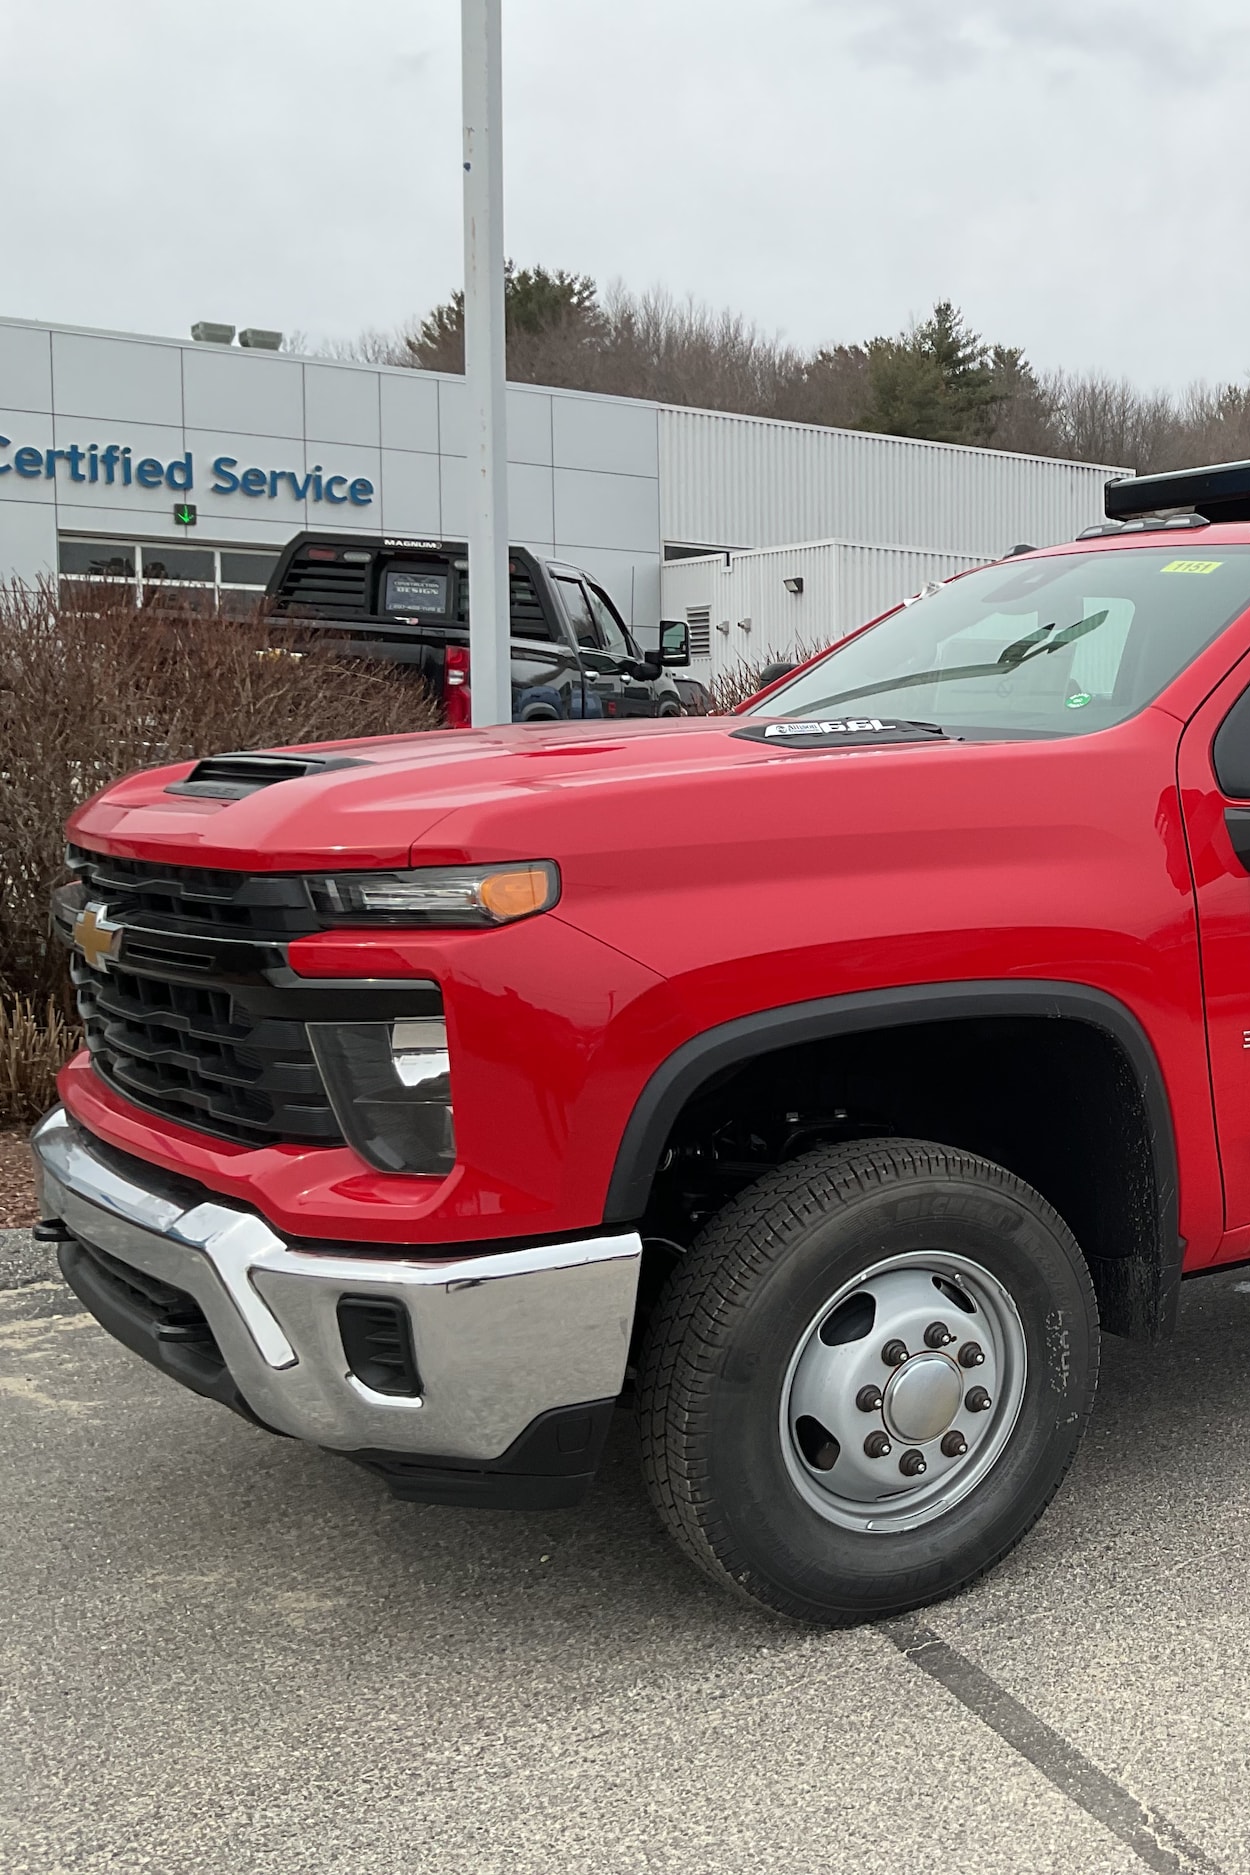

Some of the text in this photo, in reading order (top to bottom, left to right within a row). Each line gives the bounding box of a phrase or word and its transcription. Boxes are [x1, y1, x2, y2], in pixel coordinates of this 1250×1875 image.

[211, 456, 375, 506] Service
[384, 539, 437, 549] MAGNUM
[1172, 562, 1212, 572] 1151
[396, 587, 439, 595] DESIGN
